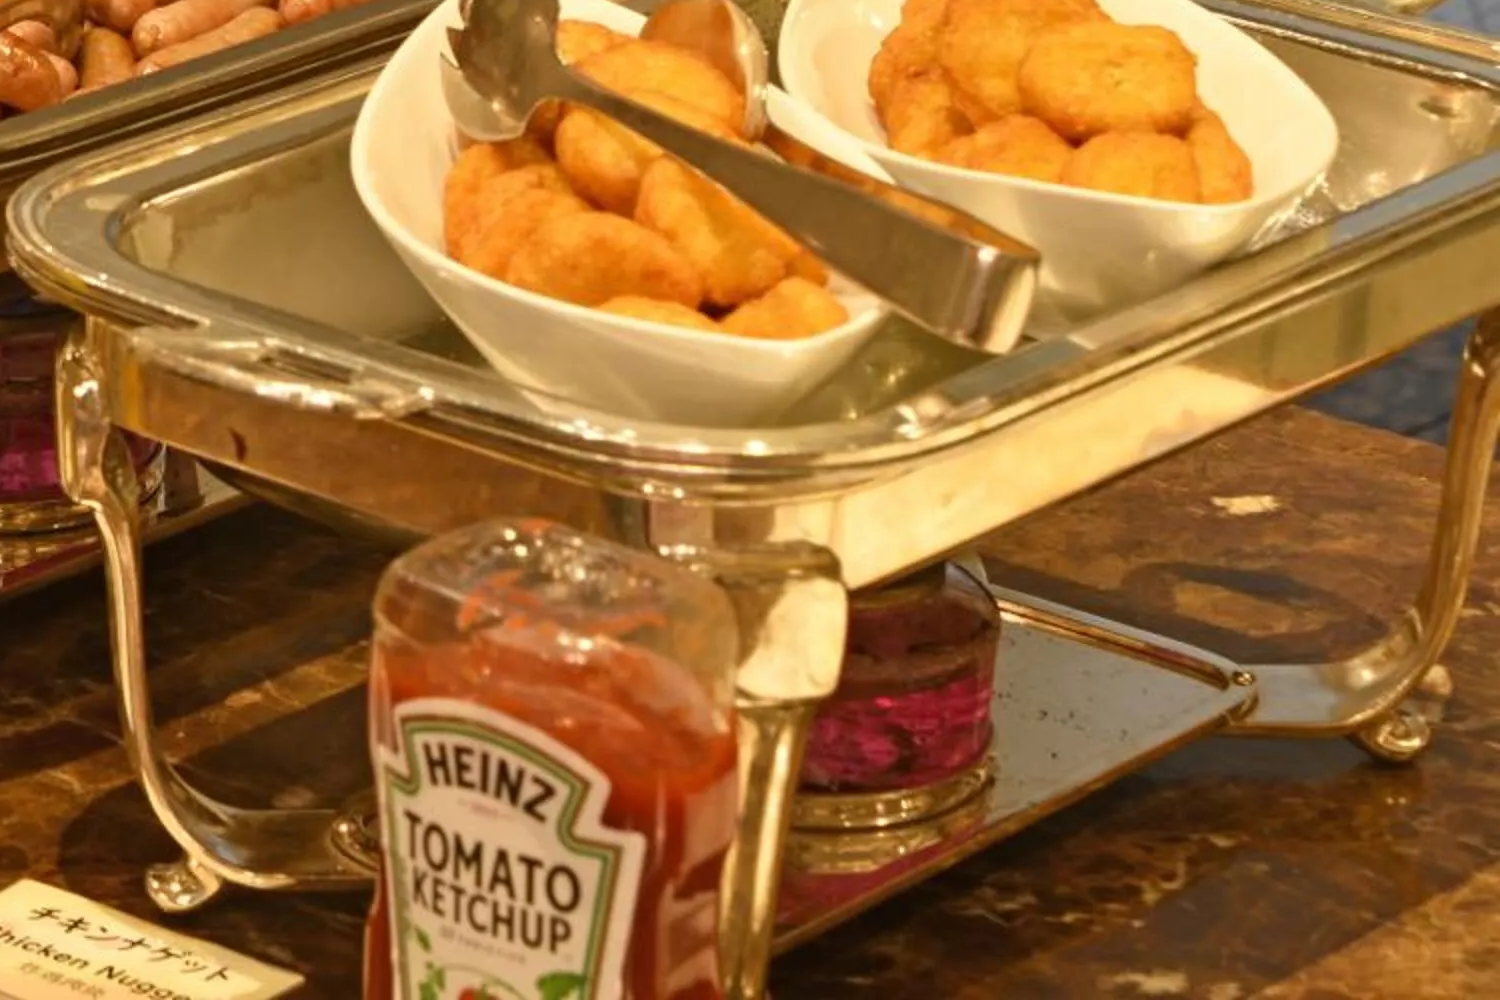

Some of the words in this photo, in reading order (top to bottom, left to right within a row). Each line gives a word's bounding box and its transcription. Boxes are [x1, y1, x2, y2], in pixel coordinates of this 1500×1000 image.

[422, 741, 556, 822] HEINZ
[403, 808, 582, 914] TOMATO
[27, 906, 229, 982] チキンナゲット
[412, 869, 572, 953] KETCHUP
